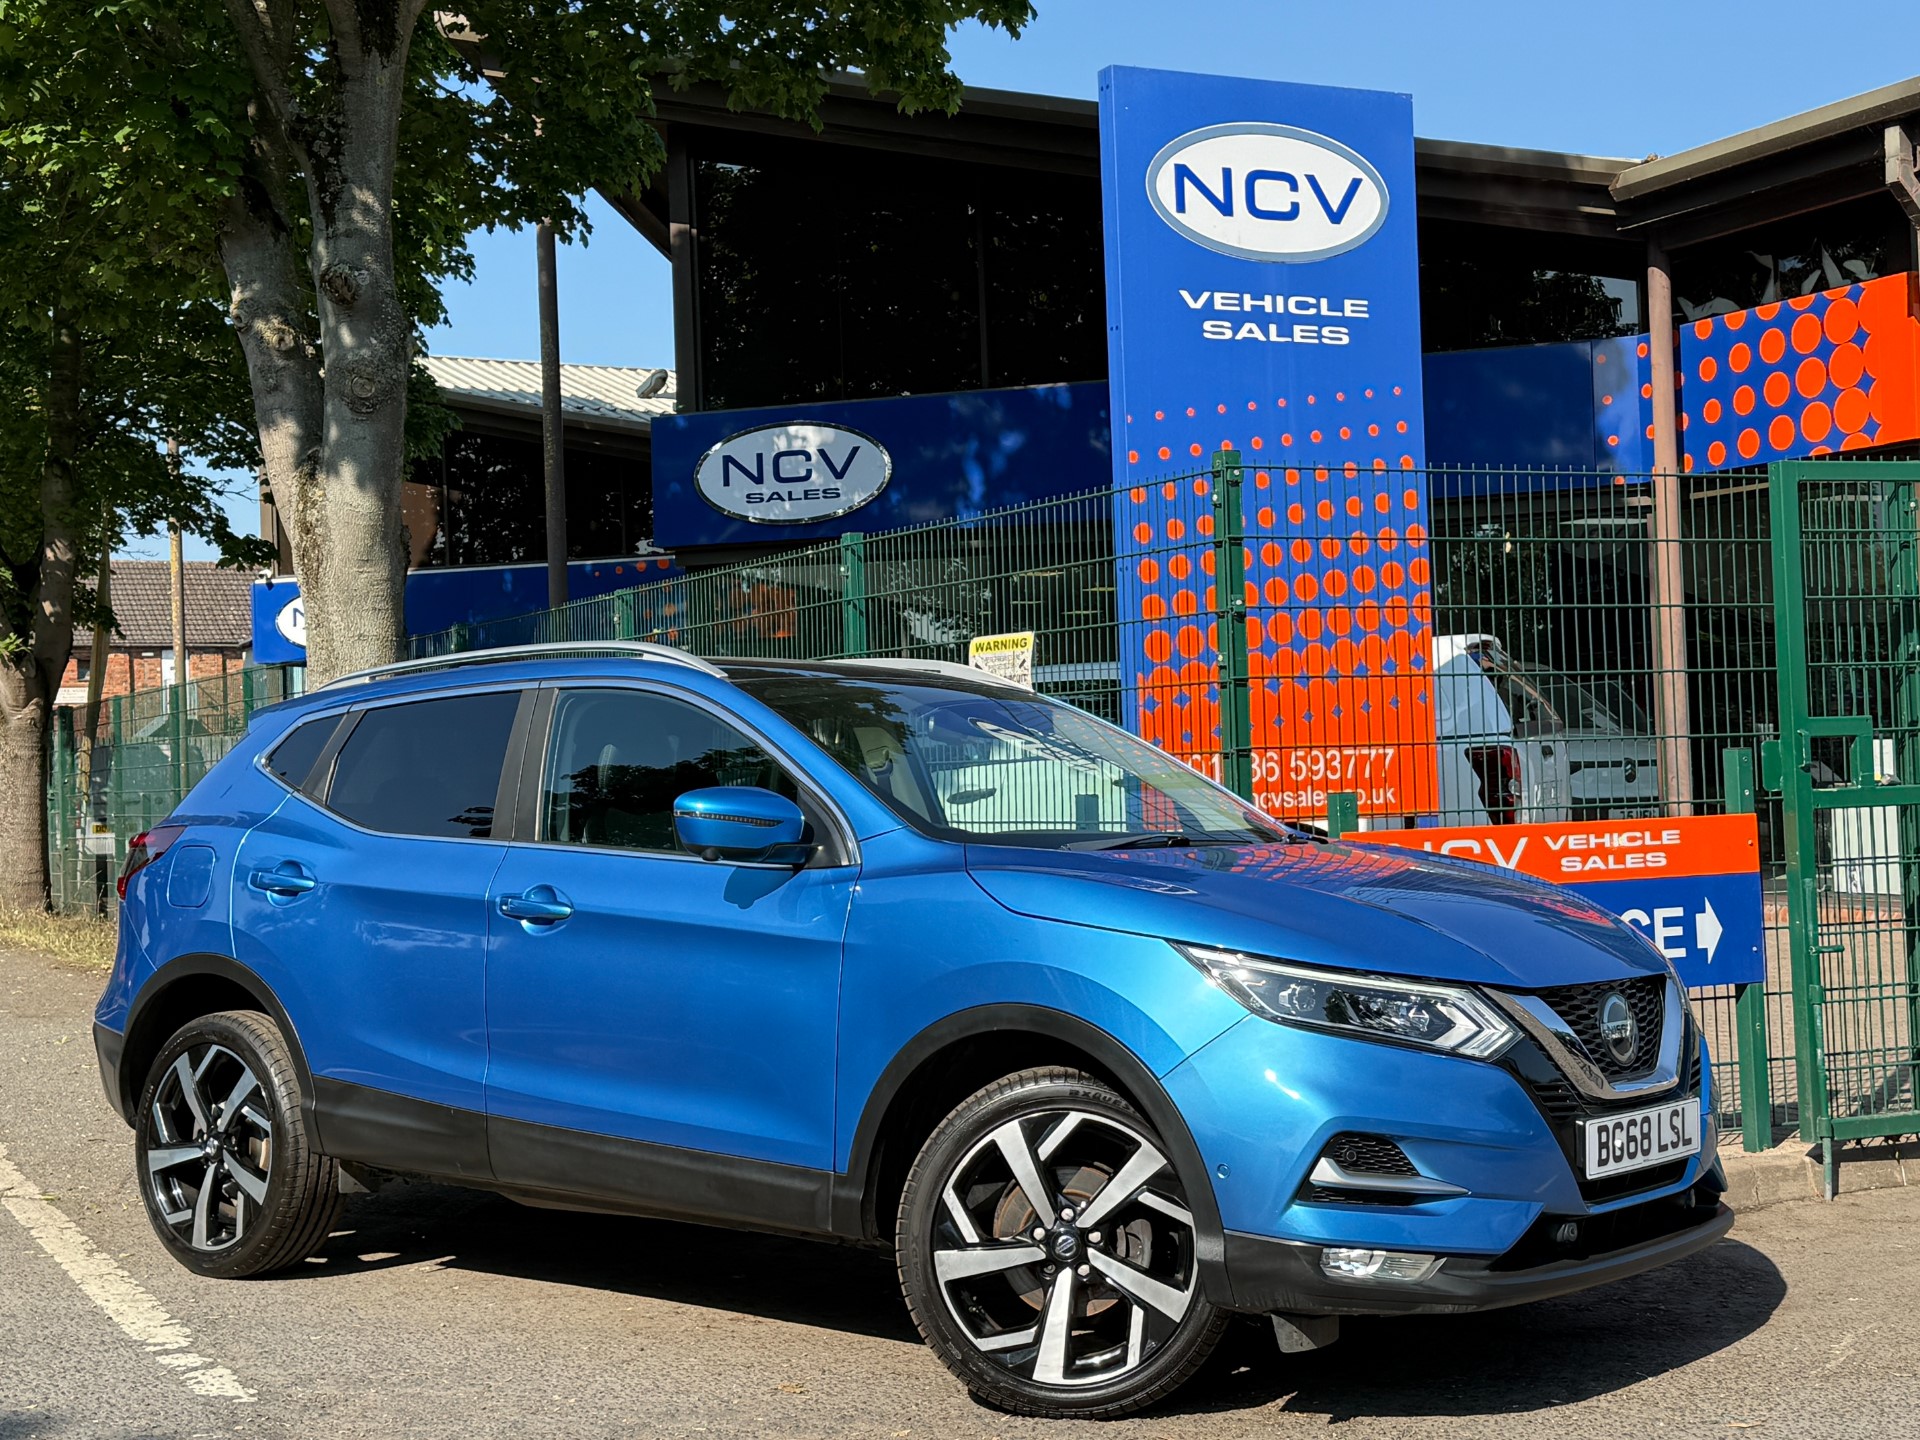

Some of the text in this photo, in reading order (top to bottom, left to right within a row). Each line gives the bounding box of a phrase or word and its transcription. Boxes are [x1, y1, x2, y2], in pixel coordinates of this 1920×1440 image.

[1174, 163, 1363, 225] NCV
[1179, 290, 1370, 318] VEHICLE
[1202, 321, 1350, 345] SALES
[722, 446, 861, 487] NCV
[745, 487, 841, 504] SALES
[975, 637, 1028, 653] WARNING
[1289, 748, 1395, 782] 593777
[1543, 829, 1681, 851] VEHICLE
[1560, 851, 1668, 873] SALES
[1597, 1106, 1693, 1168] BG68 LSL
